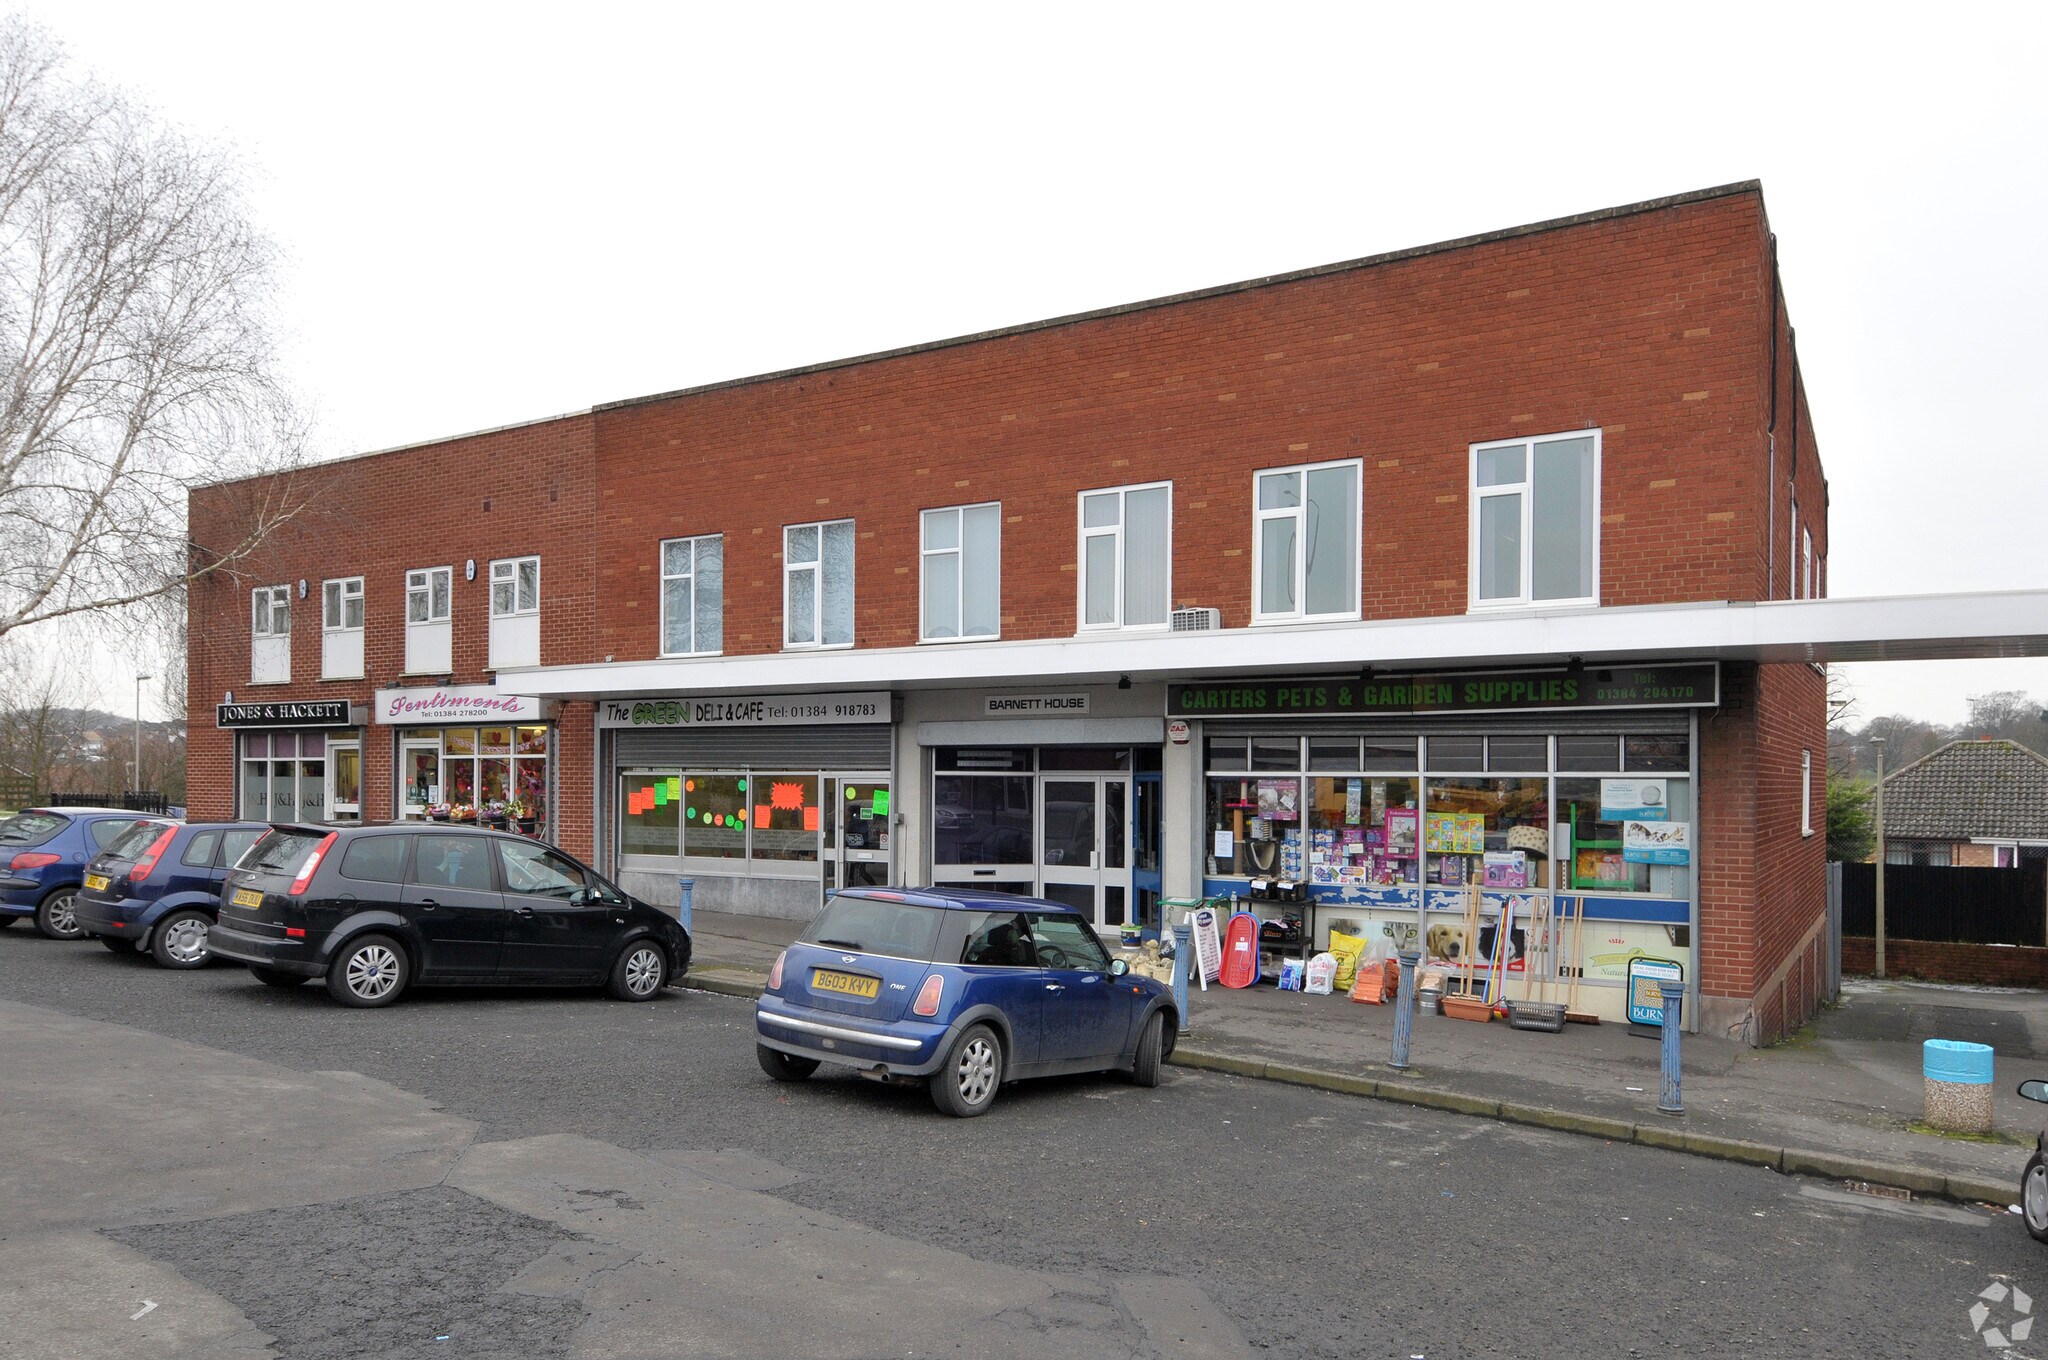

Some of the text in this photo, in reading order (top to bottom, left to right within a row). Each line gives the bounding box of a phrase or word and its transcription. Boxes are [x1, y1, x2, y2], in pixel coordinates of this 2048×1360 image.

[1181, 679, 1578, 709] CARTERS PETS & GARDEN SUPPLIES
[1596, 687, 1637, 700] 01384
[389, 691, 525, 717] Sentiments
[989, 698, 1085, 710] BARNETT HOUSE
[222, 703, 341, 722] JONES & HACKETT
[459, 709, 488, 717] 278200
[607, 703, 629, 721] The
[632, 701, 691, 725] GREEN
[696, 703, 723, 721] DELI
[735, 701, 764, 721] CAFE
[767, 706, 788, 718] Tel:
[790, 705, 828, 717] 01384
[835, 703, 876, 716] 918783
[1600, 967, 1629, 977] Natura
[817, 973, 874, 994] BG03 KVY
[889, 983, 907, 991] ONE
[1633, 1006, 1664, 1020] BURN
